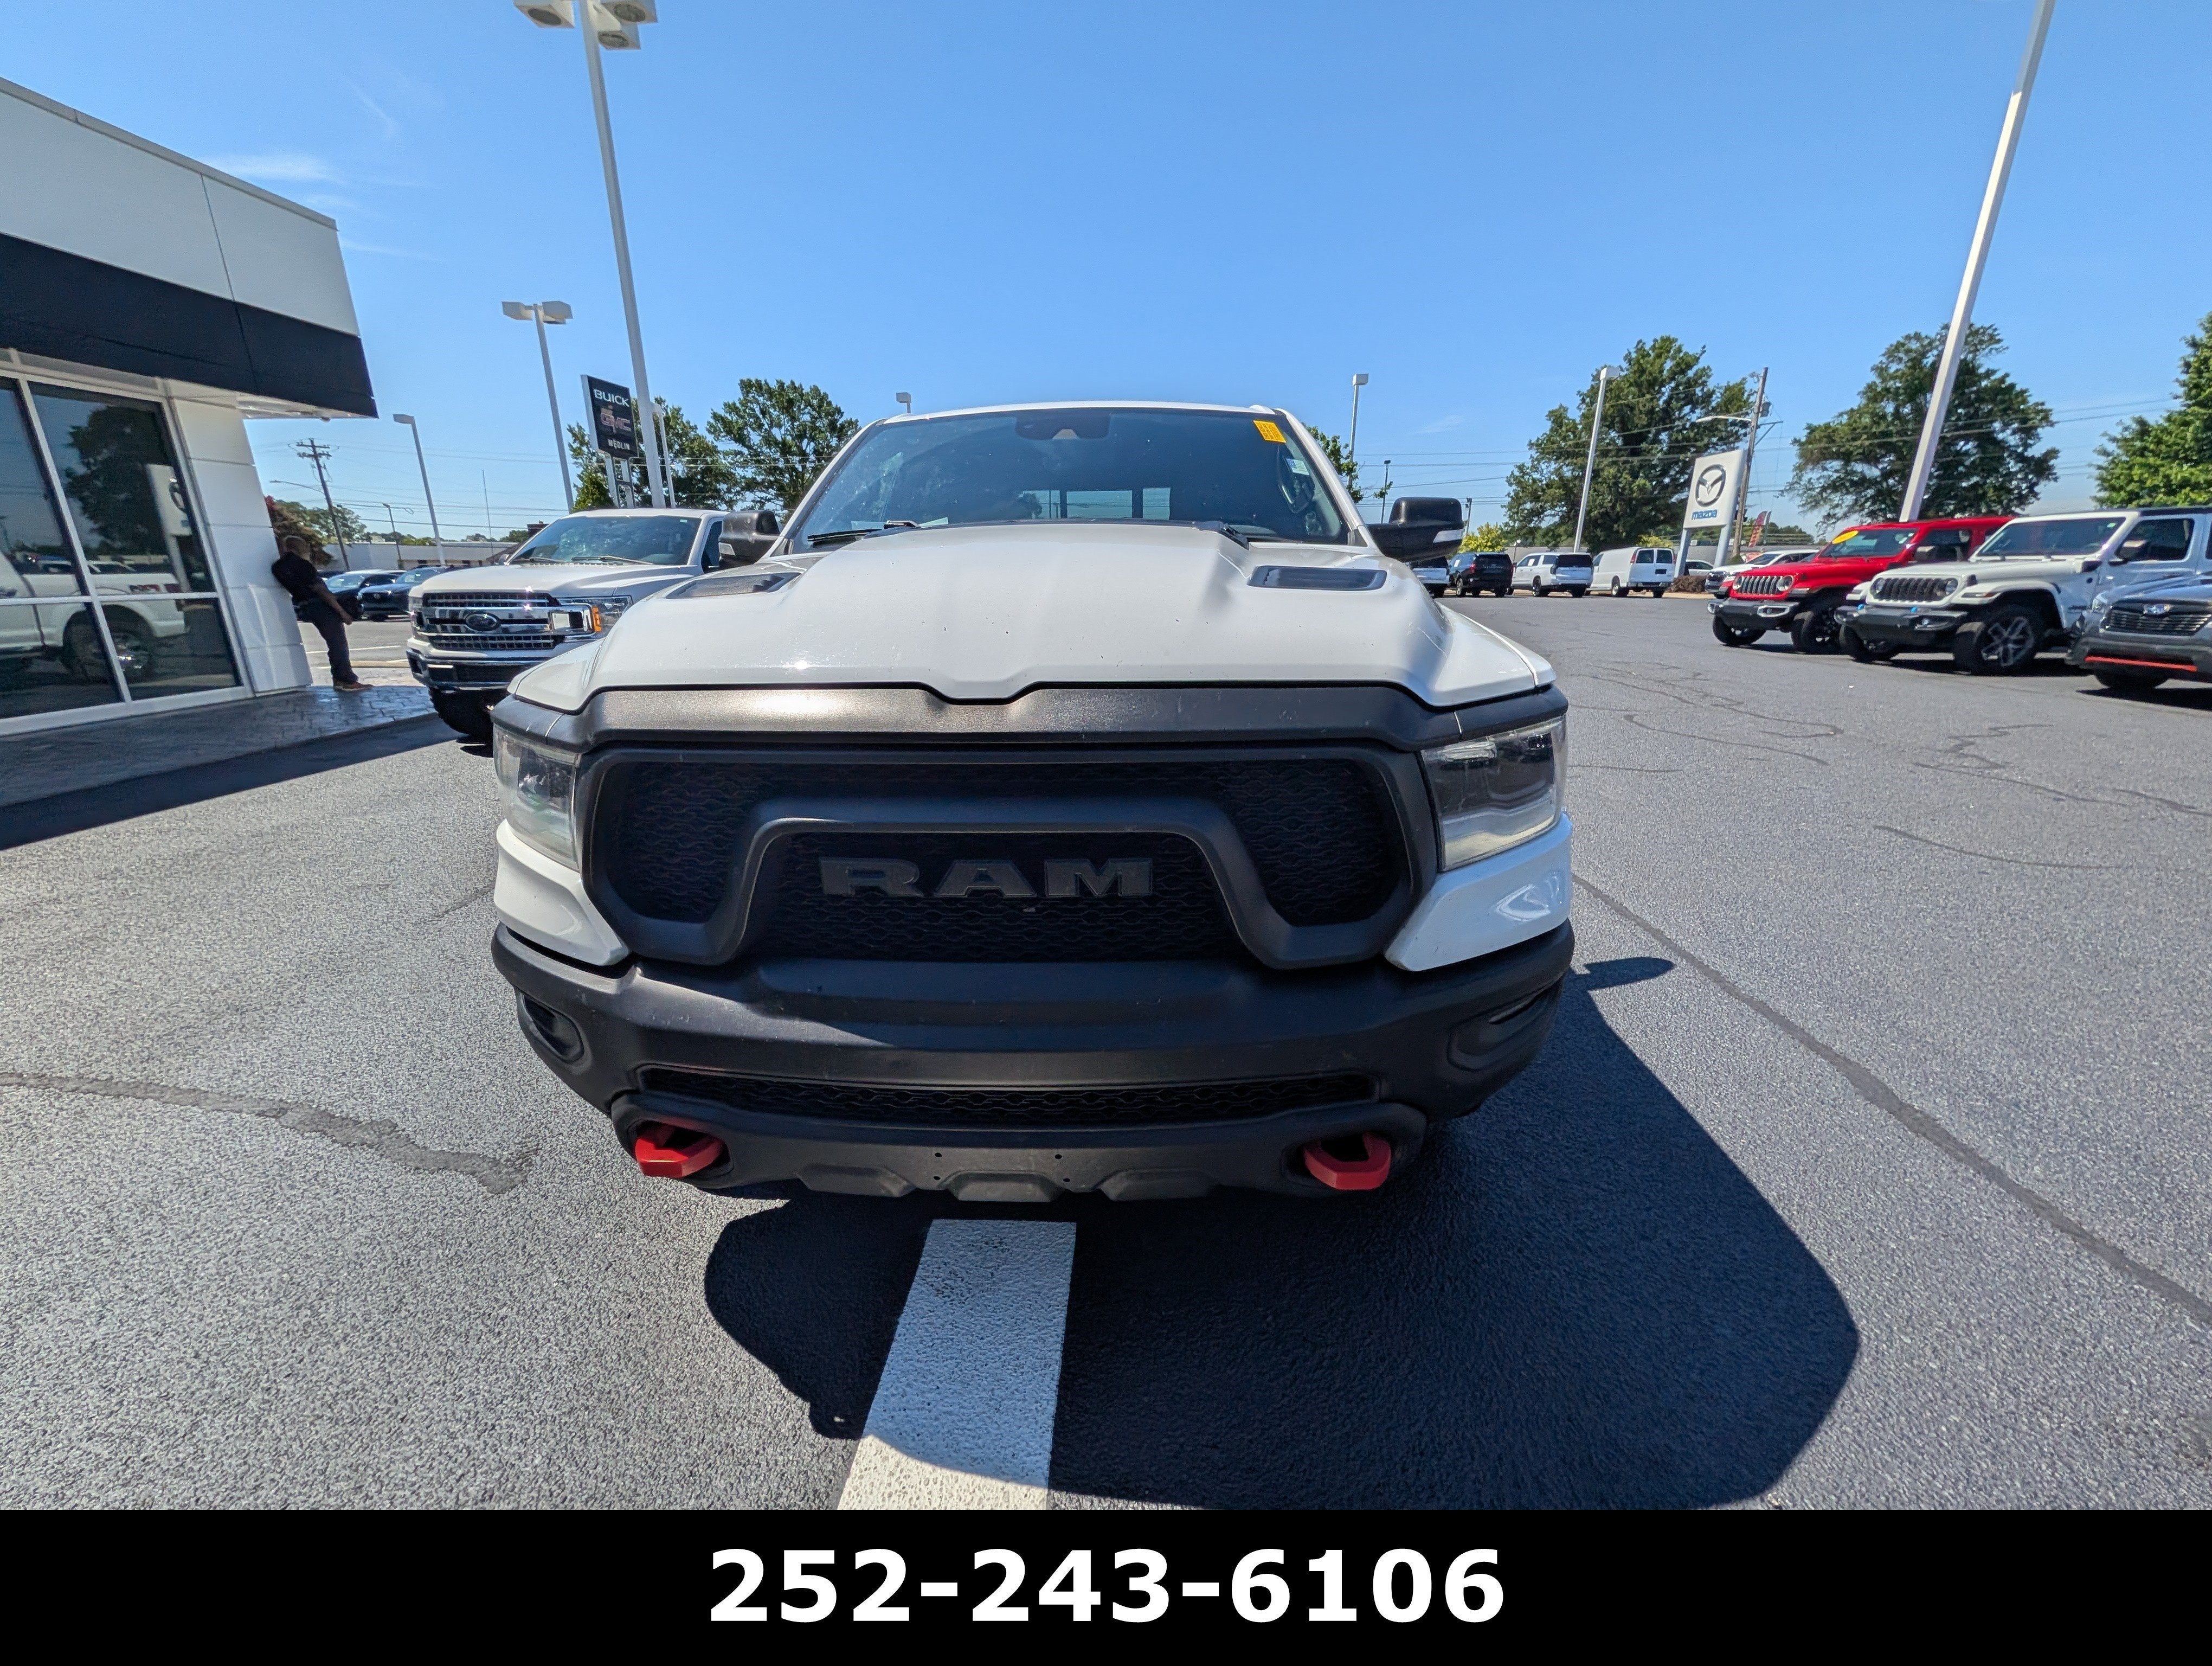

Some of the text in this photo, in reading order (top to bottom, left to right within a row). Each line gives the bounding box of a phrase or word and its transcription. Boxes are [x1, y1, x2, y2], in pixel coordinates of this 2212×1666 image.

[593, 388, 630, 407] BUICK
[600, 412, 631, 434] GMC
[1692, 509, 1718, 520] mazda
[819, 857, 1154, 898] RAM
